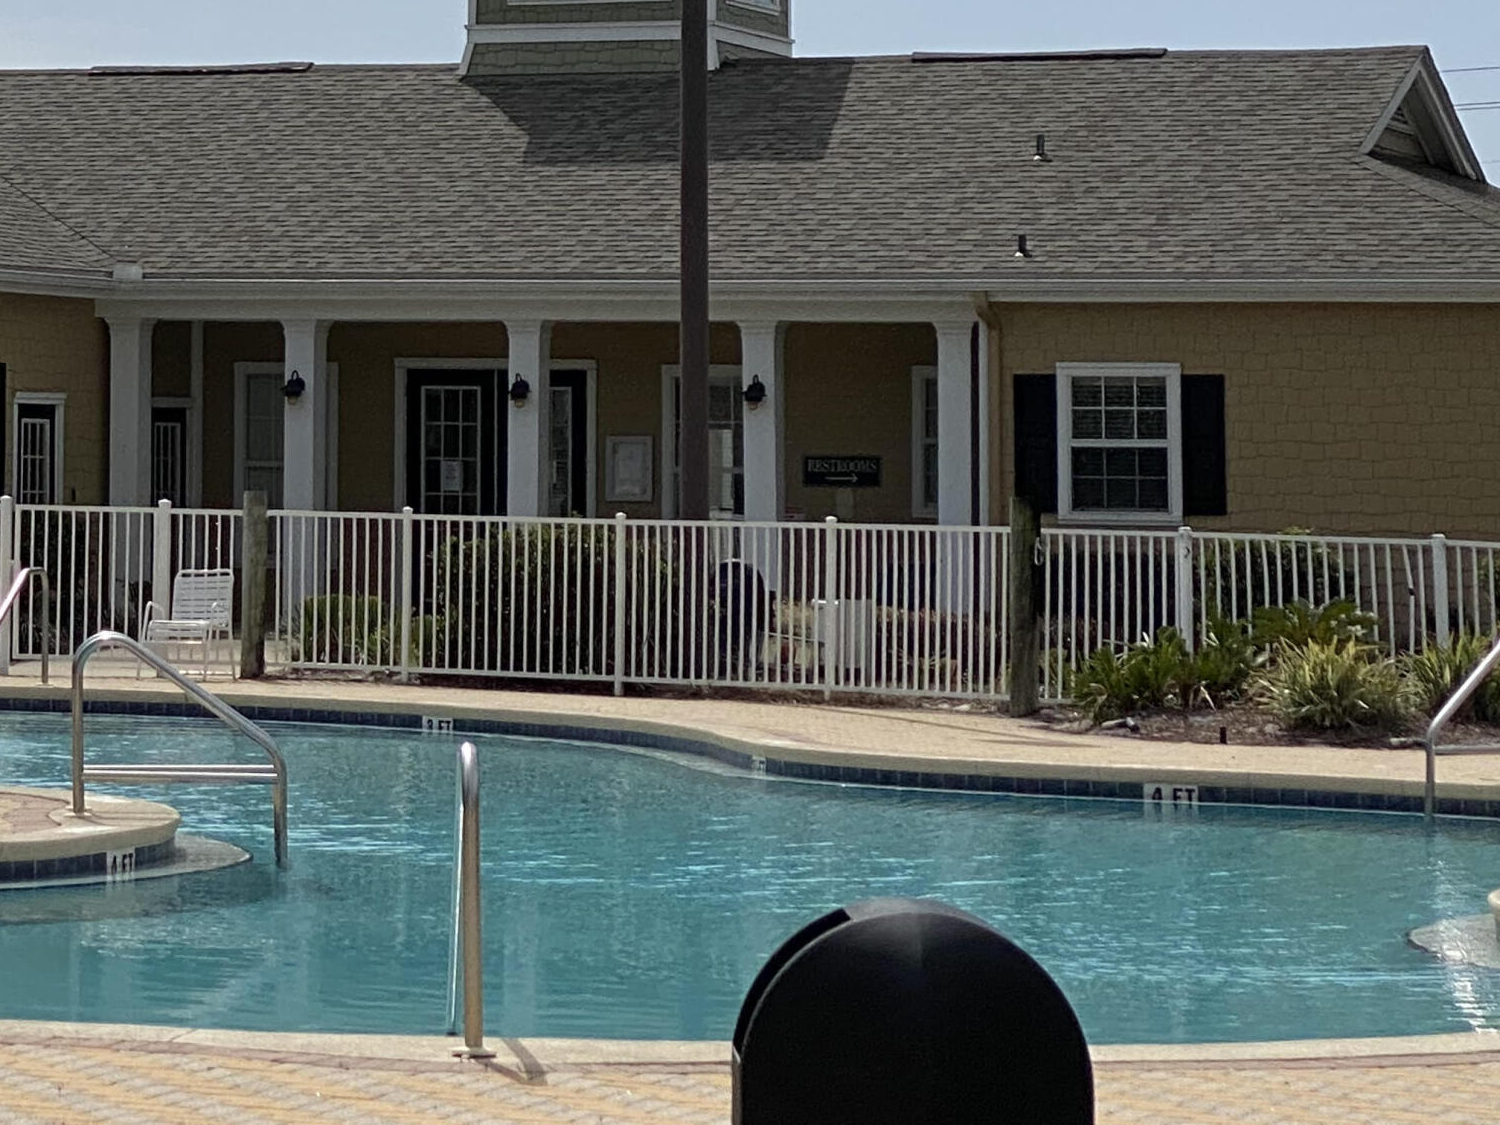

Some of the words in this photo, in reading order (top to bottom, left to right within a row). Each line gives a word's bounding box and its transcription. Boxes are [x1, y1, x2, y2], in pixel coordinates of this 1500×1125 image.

[807, 459, 877, 473] RESTROOMS
[438, 720, 451, 731] FT
[1173, 788, 1196, 802] FT
